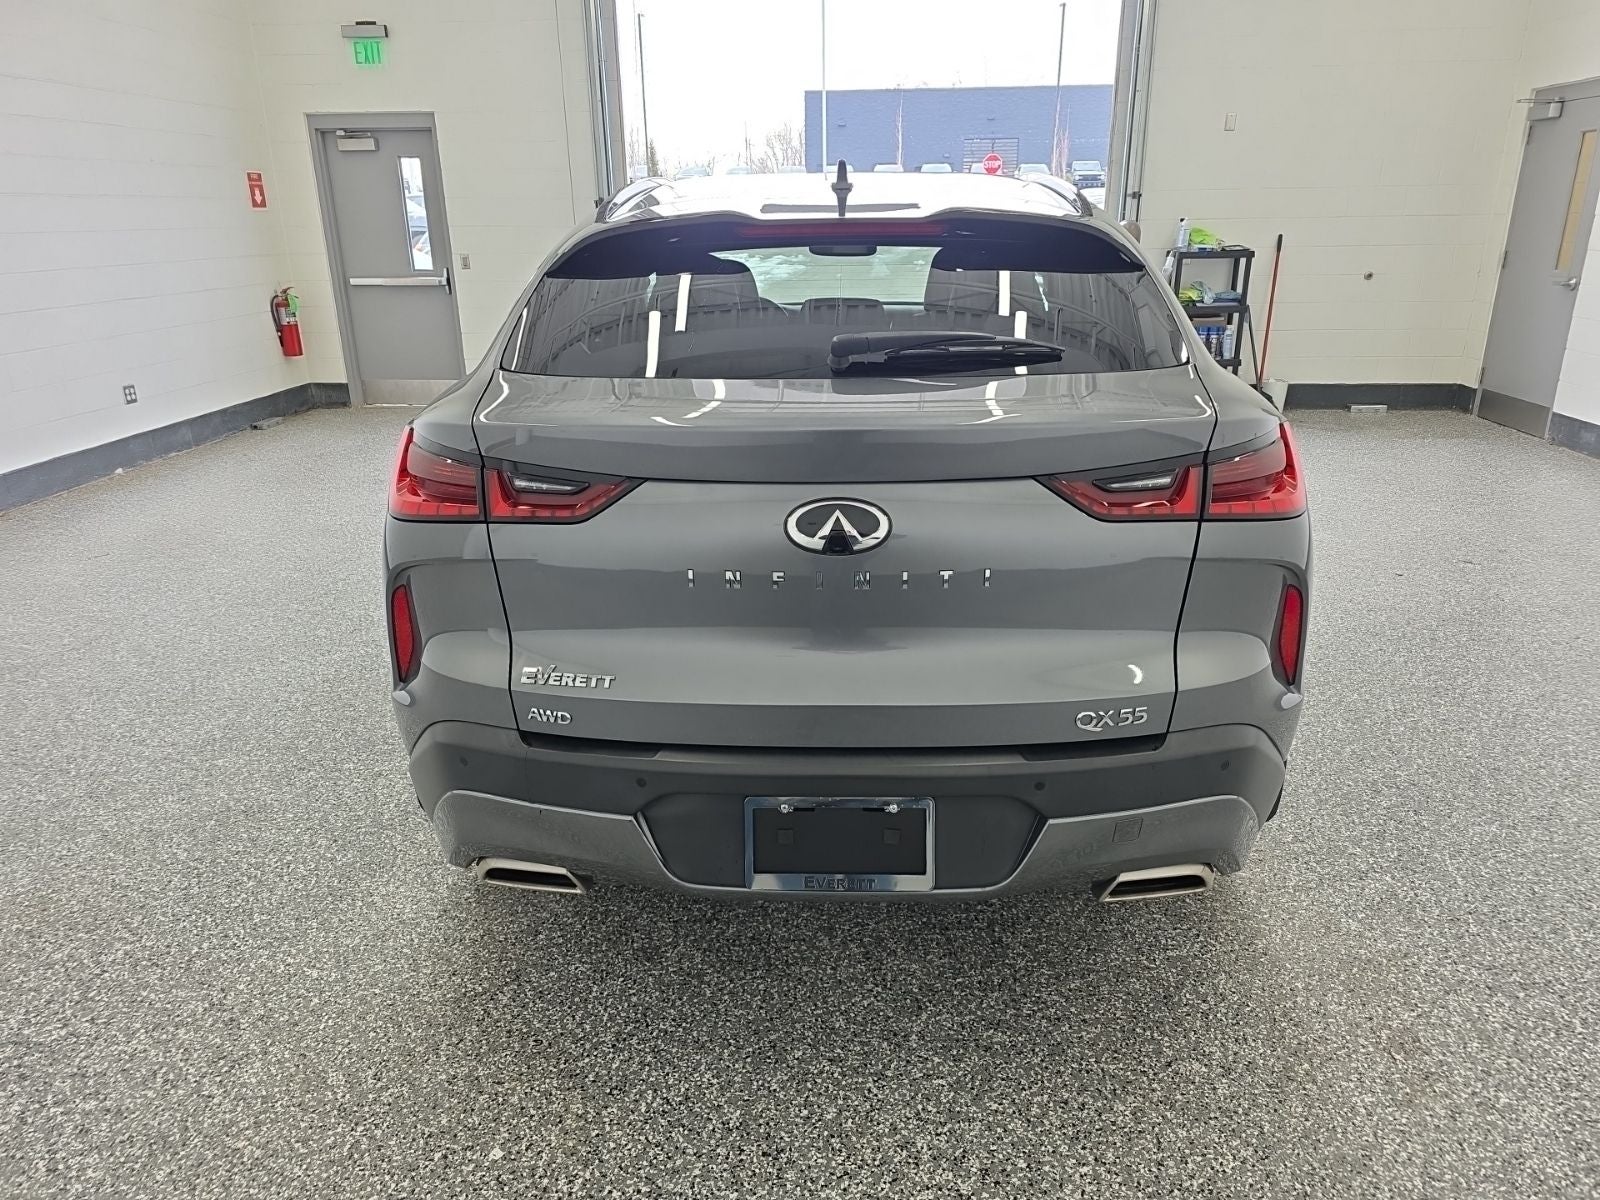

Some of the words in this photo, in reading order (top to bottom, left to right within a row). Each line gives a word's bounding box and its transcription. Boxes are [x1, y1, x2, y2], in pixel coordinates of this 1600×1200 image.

[353, 41, 381, 64] EXIT
[983, 161, 1001, 169] STOP
[687, 568, 993, 589] INFINITI
[520, 664, 616, 689] EVERETT
[528, 707, 572, 725] AWD
[804, 875, 876, 890] EVERETT
